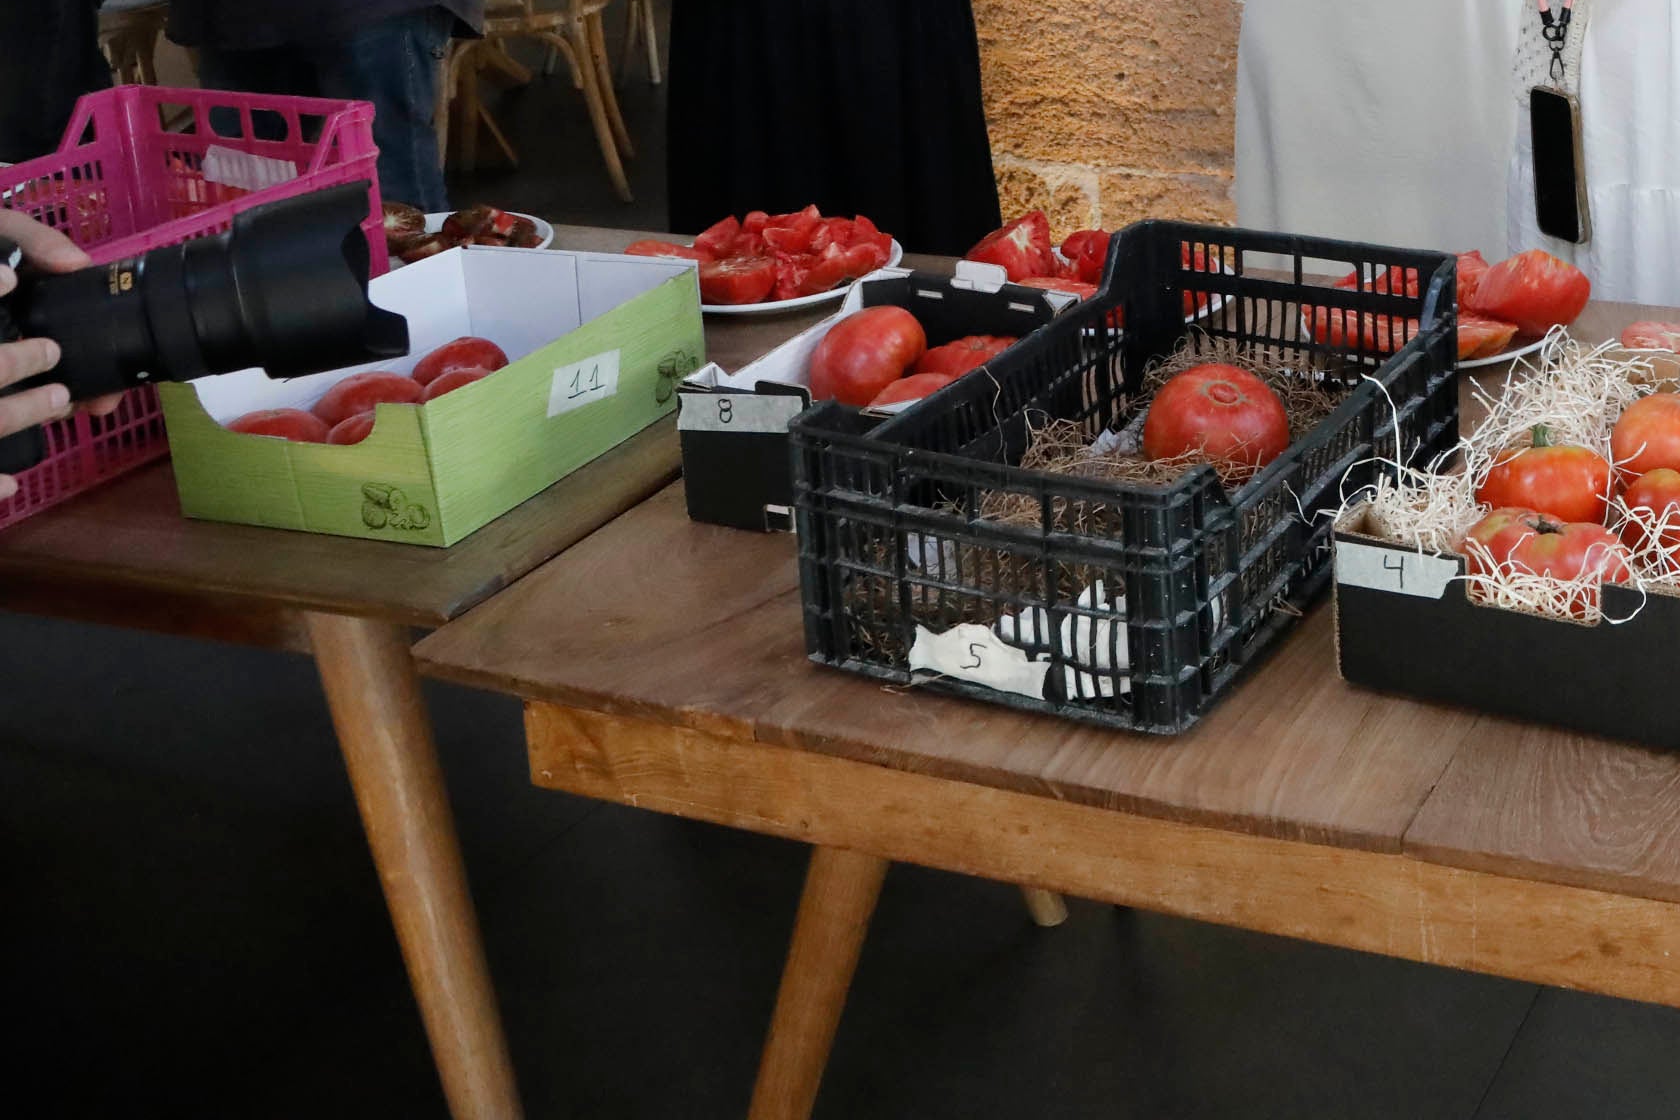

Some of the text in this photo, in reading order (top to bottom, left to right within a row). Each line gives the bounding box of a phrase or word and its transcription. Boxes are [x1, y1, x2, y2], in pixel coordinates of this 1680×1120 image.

[567, 364, 605, 399] 11
[718, 399, 732, 423] 8
[1383, 554, 1404, 589] 4
[960, 643, 988, 669] 5
